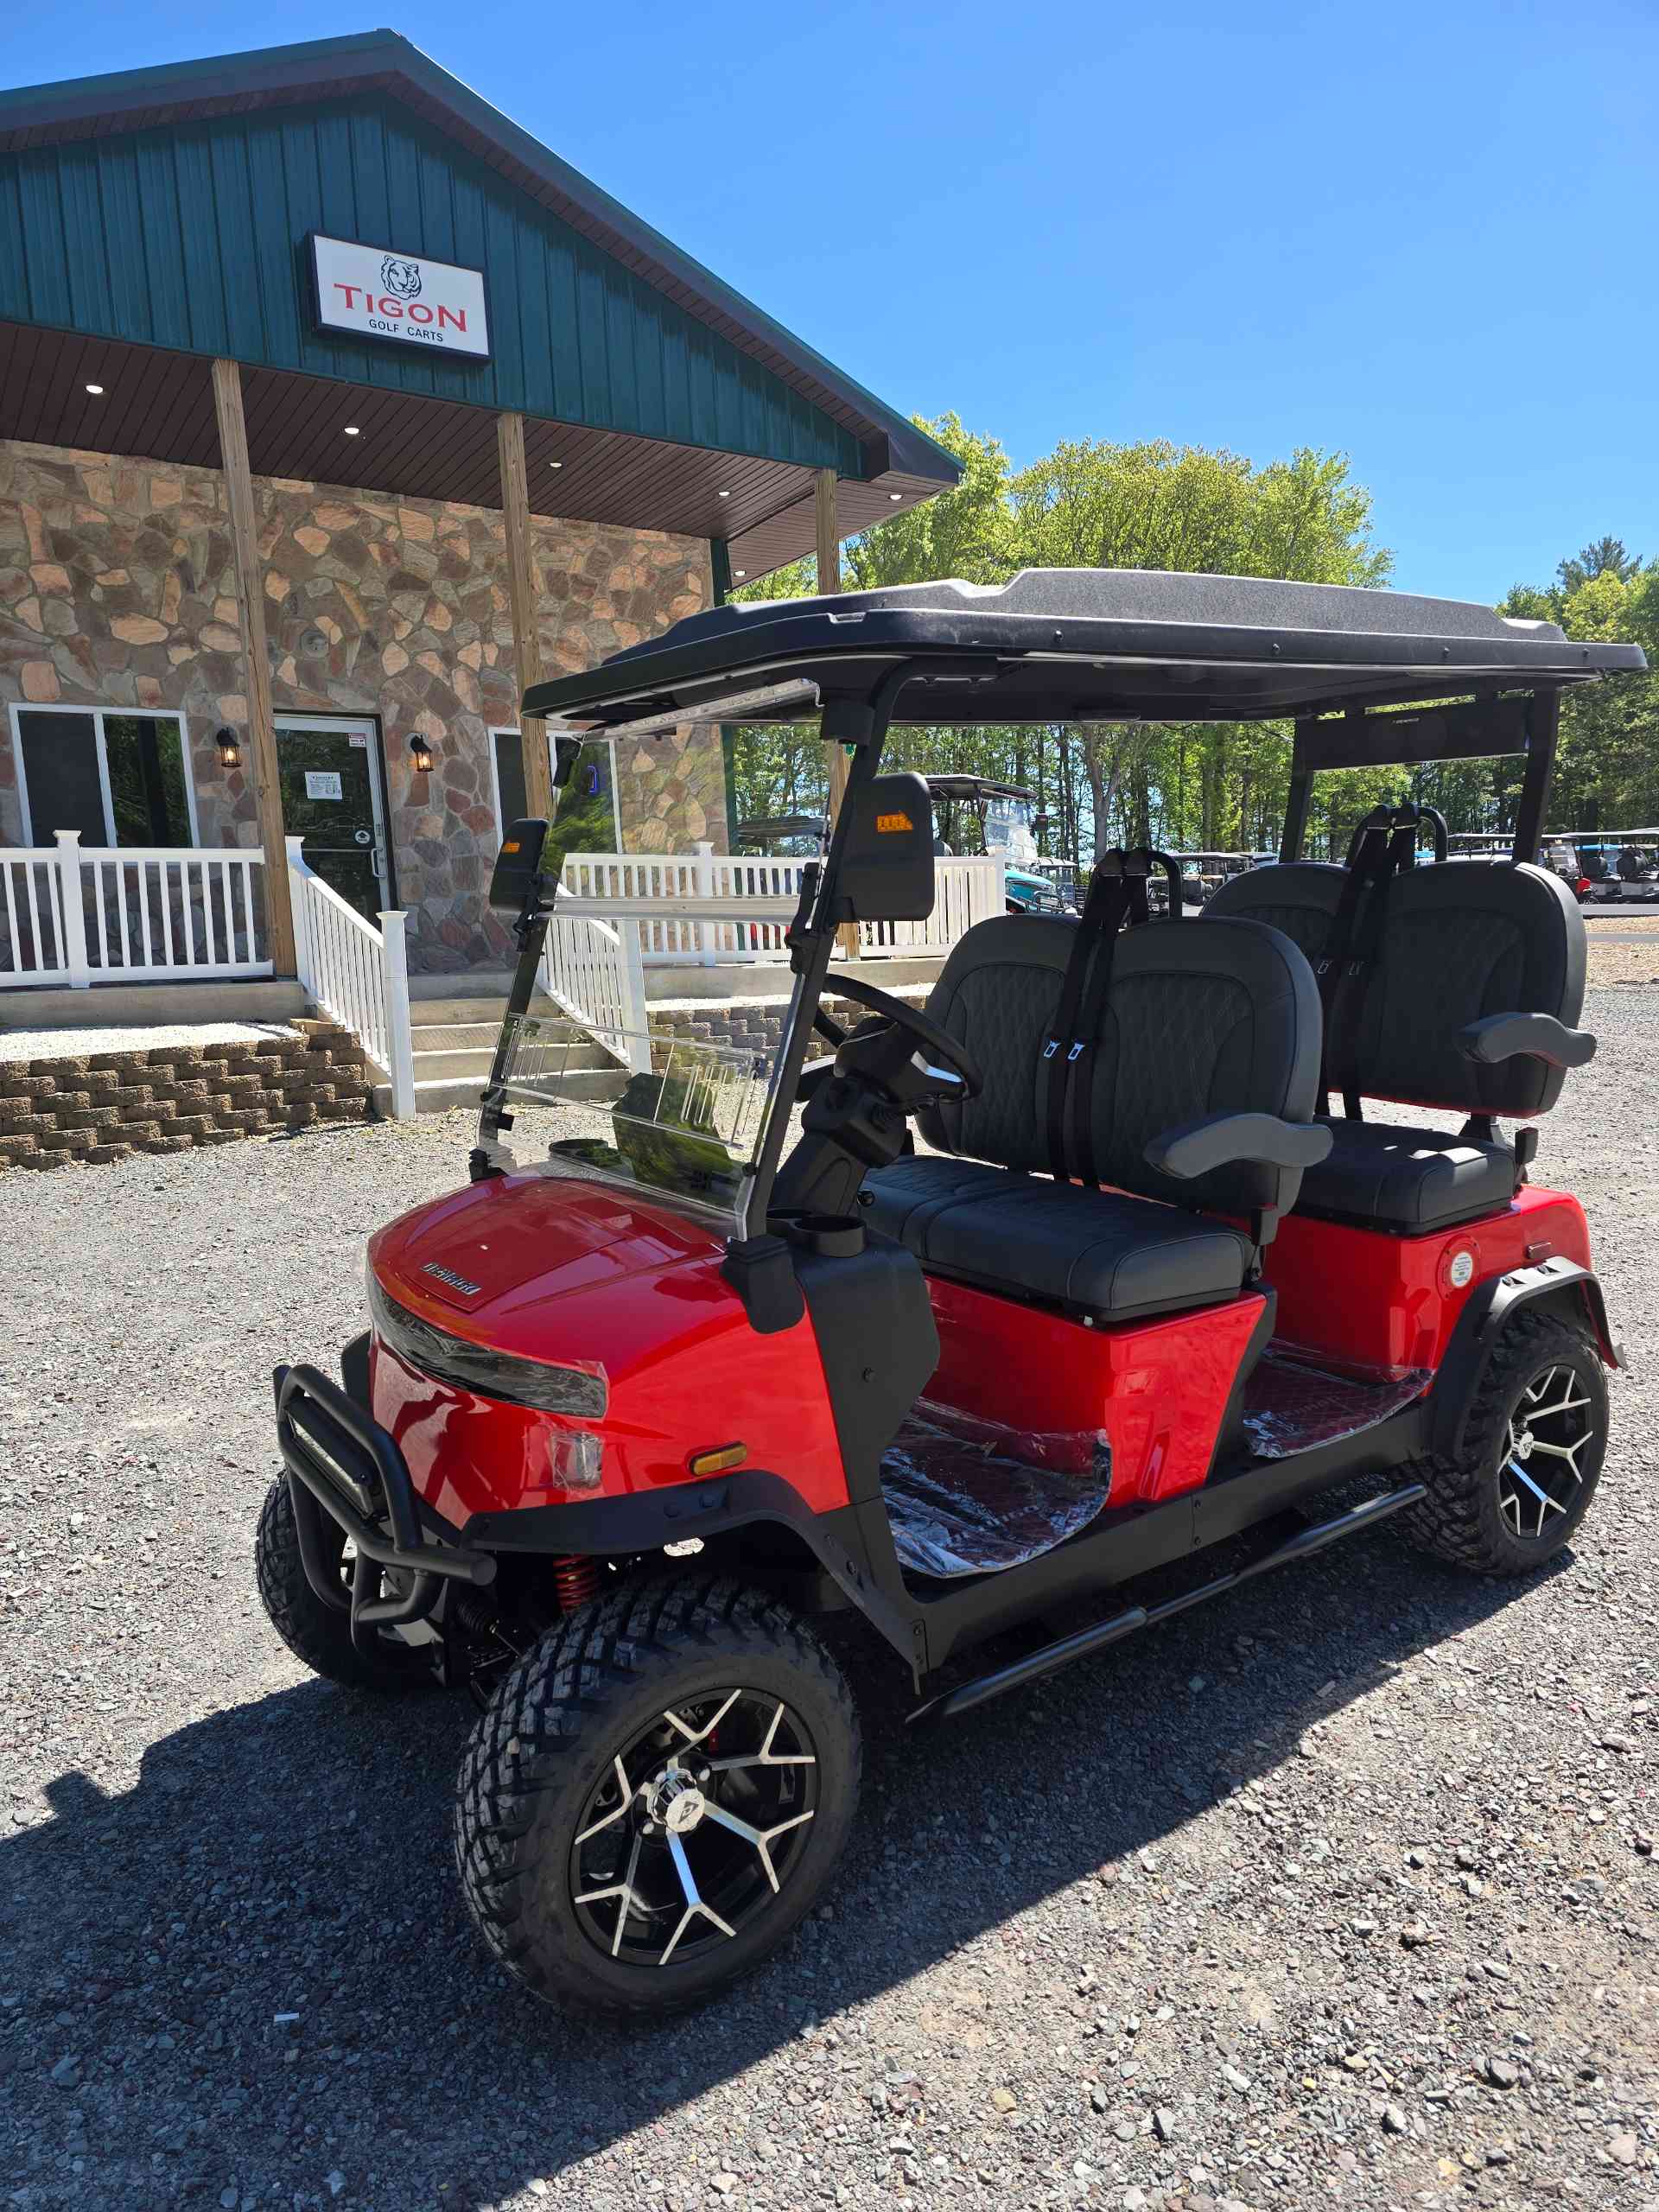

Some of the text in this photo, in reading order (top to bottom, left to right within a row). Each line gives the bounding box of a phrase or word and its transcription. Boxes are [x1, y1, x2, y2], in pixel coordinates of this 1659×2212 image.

[334, 283, 467, 333] TIGON
[369, 319, 443, 342] GOLF CARTS
